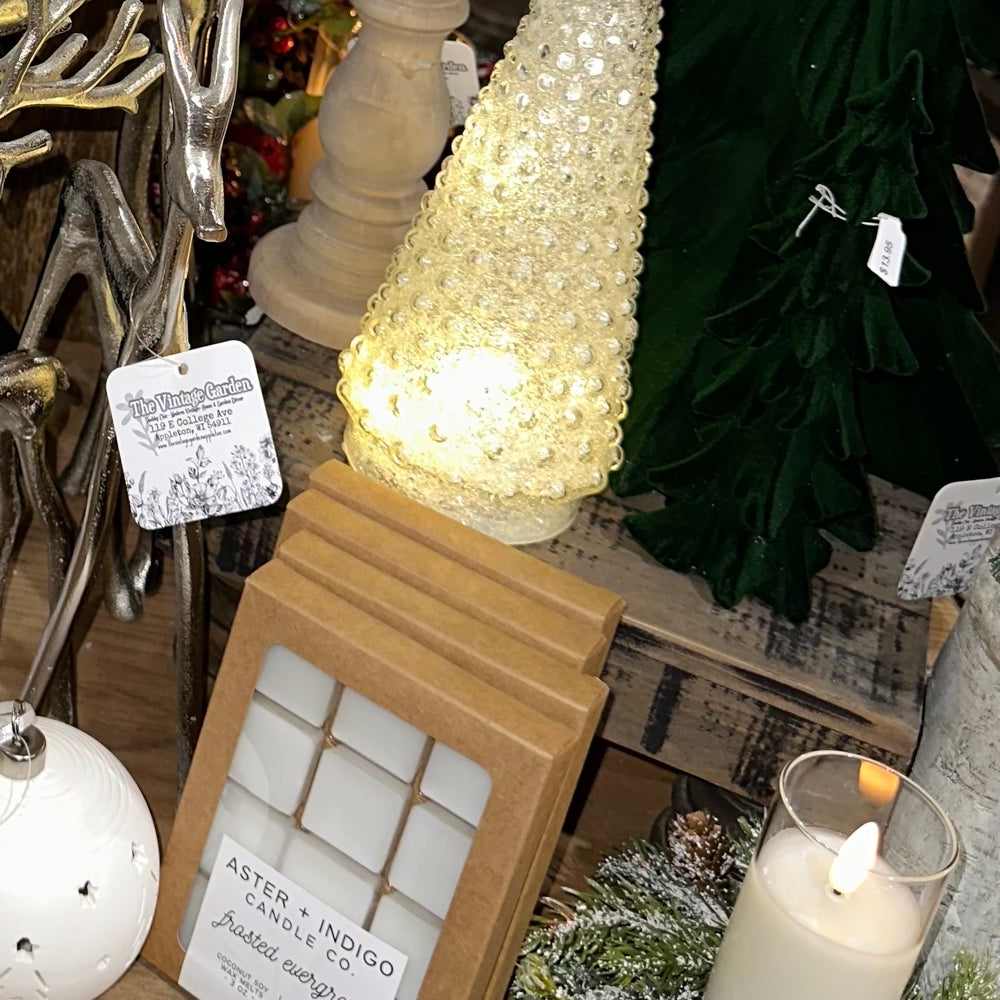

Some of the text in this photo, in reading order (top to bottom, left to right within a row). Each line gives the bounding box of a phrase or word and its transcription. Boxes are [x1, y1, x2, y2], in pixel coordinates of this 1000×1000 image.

[130, 375, 254, 419] The Vintage Garden
[150, 408, 233, 434] 119 E College Ave
[154, 417, 232, 442] Appleton, WI 54911
[211, 909, 278, 962] frosted
[226, 857, 289, 909] ASTER
[318, 918, 394, 978] INDIGO
[245, 892, 355, 977] CANDLE CO.
[217, 951, 270, 994] COCONUT SOY
[220, 963, 264, 999] WAX MELTS
